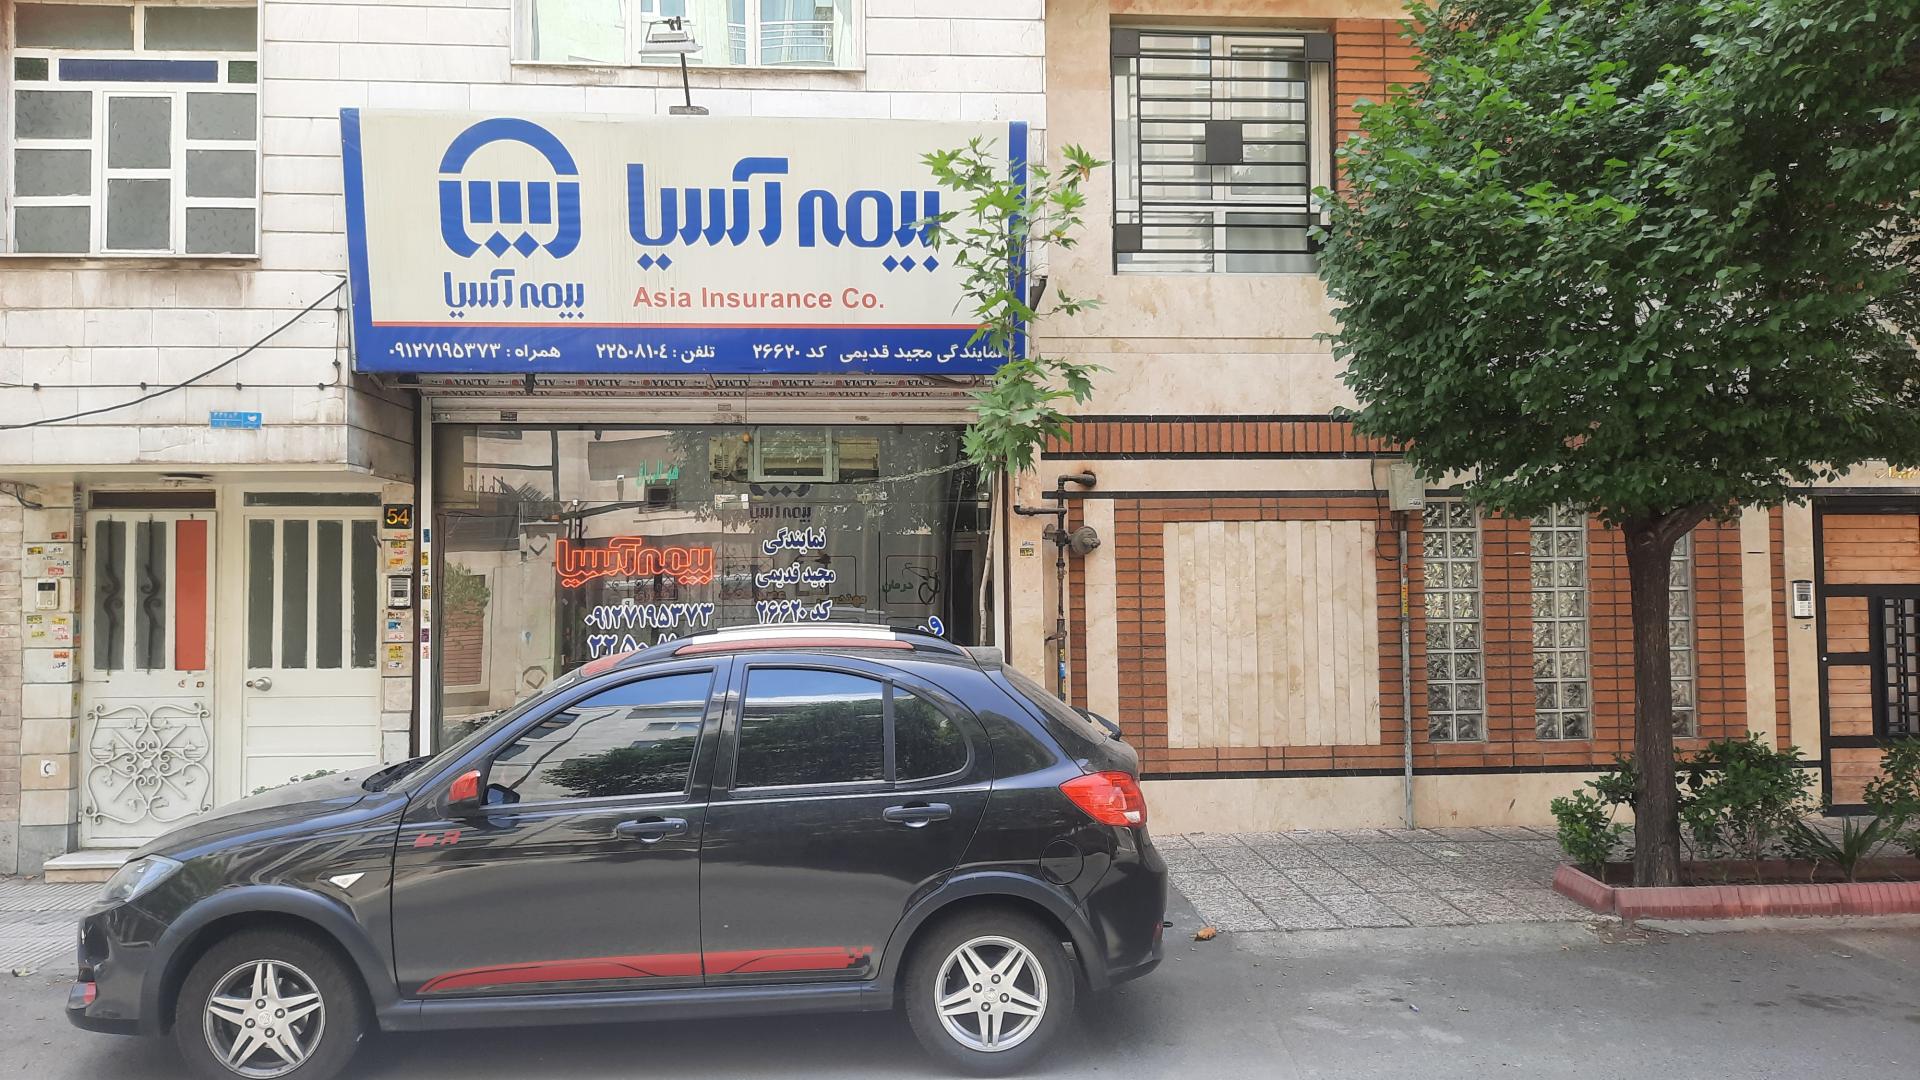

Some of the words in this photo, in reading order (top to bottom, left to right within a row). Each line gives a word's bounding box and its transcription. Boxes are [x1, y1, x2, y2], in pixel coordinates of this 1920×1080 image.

[627, 157, 789, 271] آسیا
[798, 189, 940, 273] بیمه
[443, 268, 516, 319] آسیا
[519, 283, 585, 319] بیمه
[633, 286, 692, 308] Asia
[702, 287, 833, 309] Insurance
[841, 288, 885, 309] Co.
[515, 344, 561, 362] همراه
[681, 344, 716, 364] تلفن
[752, 343, 800, 360] ۲۶۶۲۰
[805, 345, 827, 359] کد
[839, 344, 889, 364] قدیمی
[893, 346, 932, 362] مجید
[386, 508, 410, 525] 54
[763, 527, 826, 555] نمایندگی
[556, 537, 642, 588] آسیا
[637, 548, 713, 584] بیمه
[755, 562, 800, 588] قدیمی
[802, 566, 836, 587] مجید
[584, 603, 715, 630] ۰۹۱۲۷۱۹۵۳۷۳
[755, 599, 808, 624] ۲۶۶۲۰
[810, 600, 833, 621] کد
